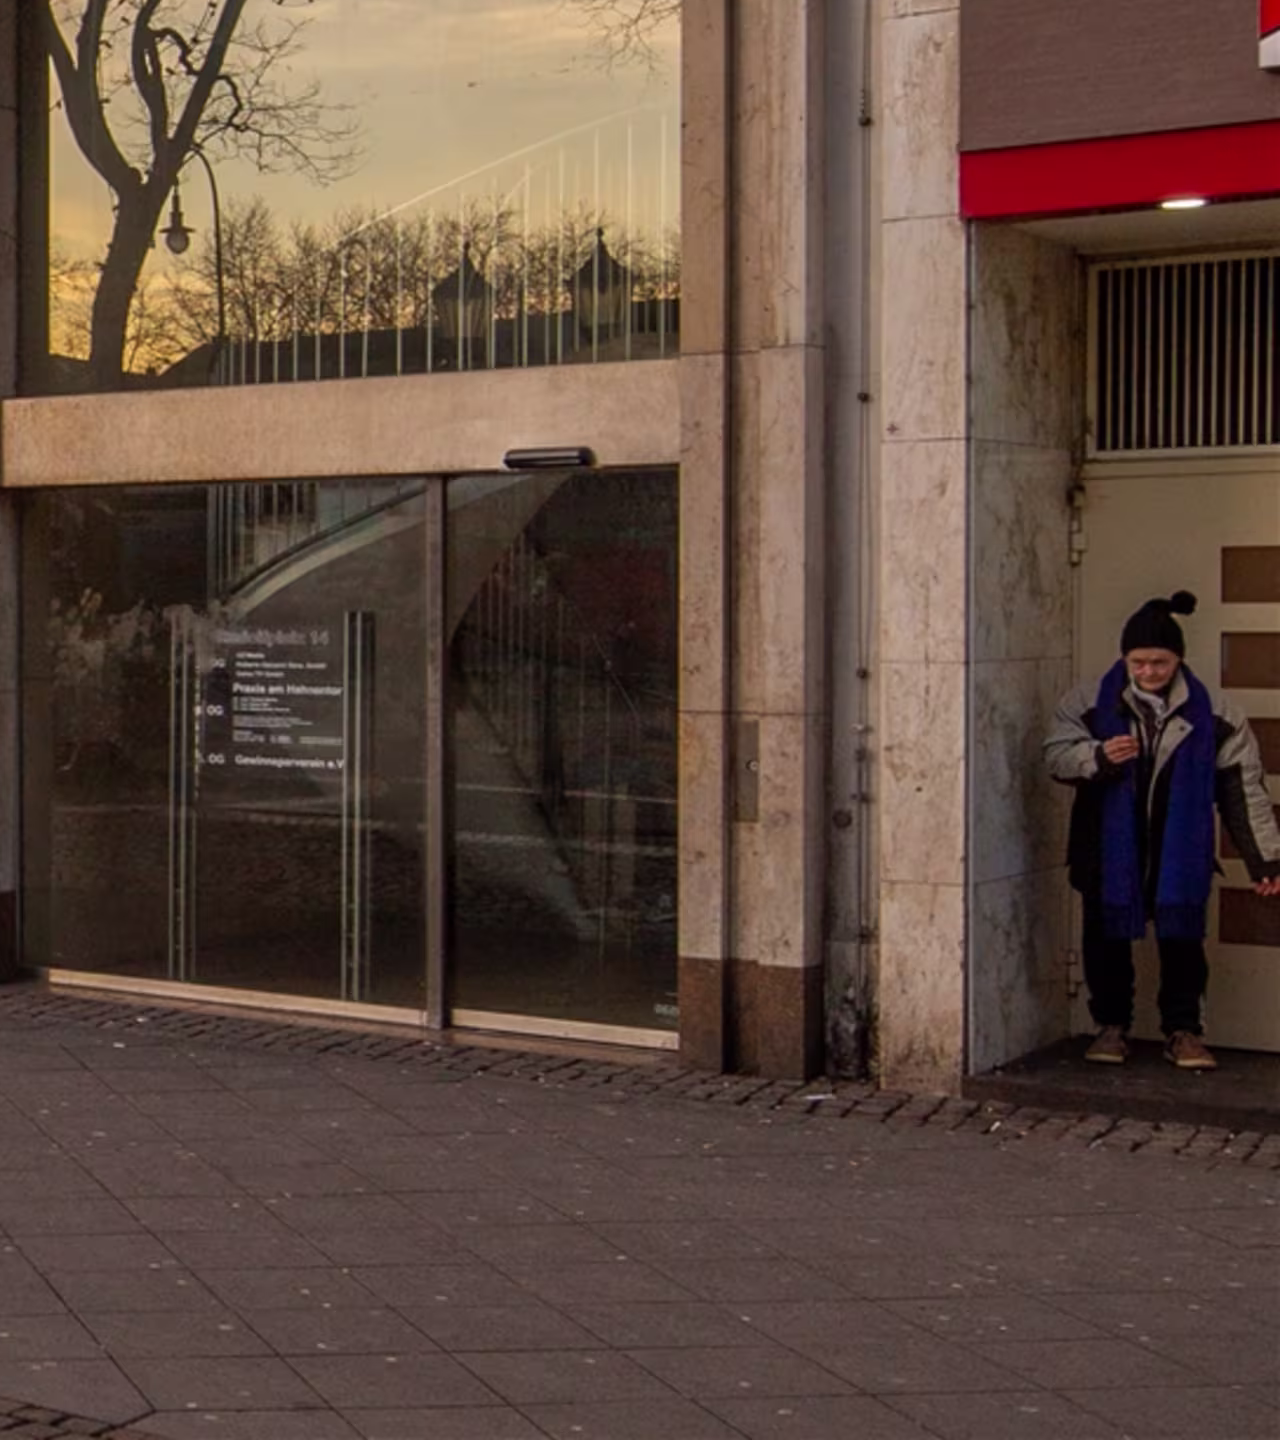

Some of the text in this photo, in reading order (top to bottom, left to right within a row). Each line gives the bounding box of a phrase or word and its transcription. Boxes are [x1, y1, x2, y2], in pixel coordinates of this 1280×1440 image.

[232, 682, 266, 694] Praxis
[268, 686, 284, 695] am
[206, 705, 224, 716] OG
[207, 753, 224, 765] OG
